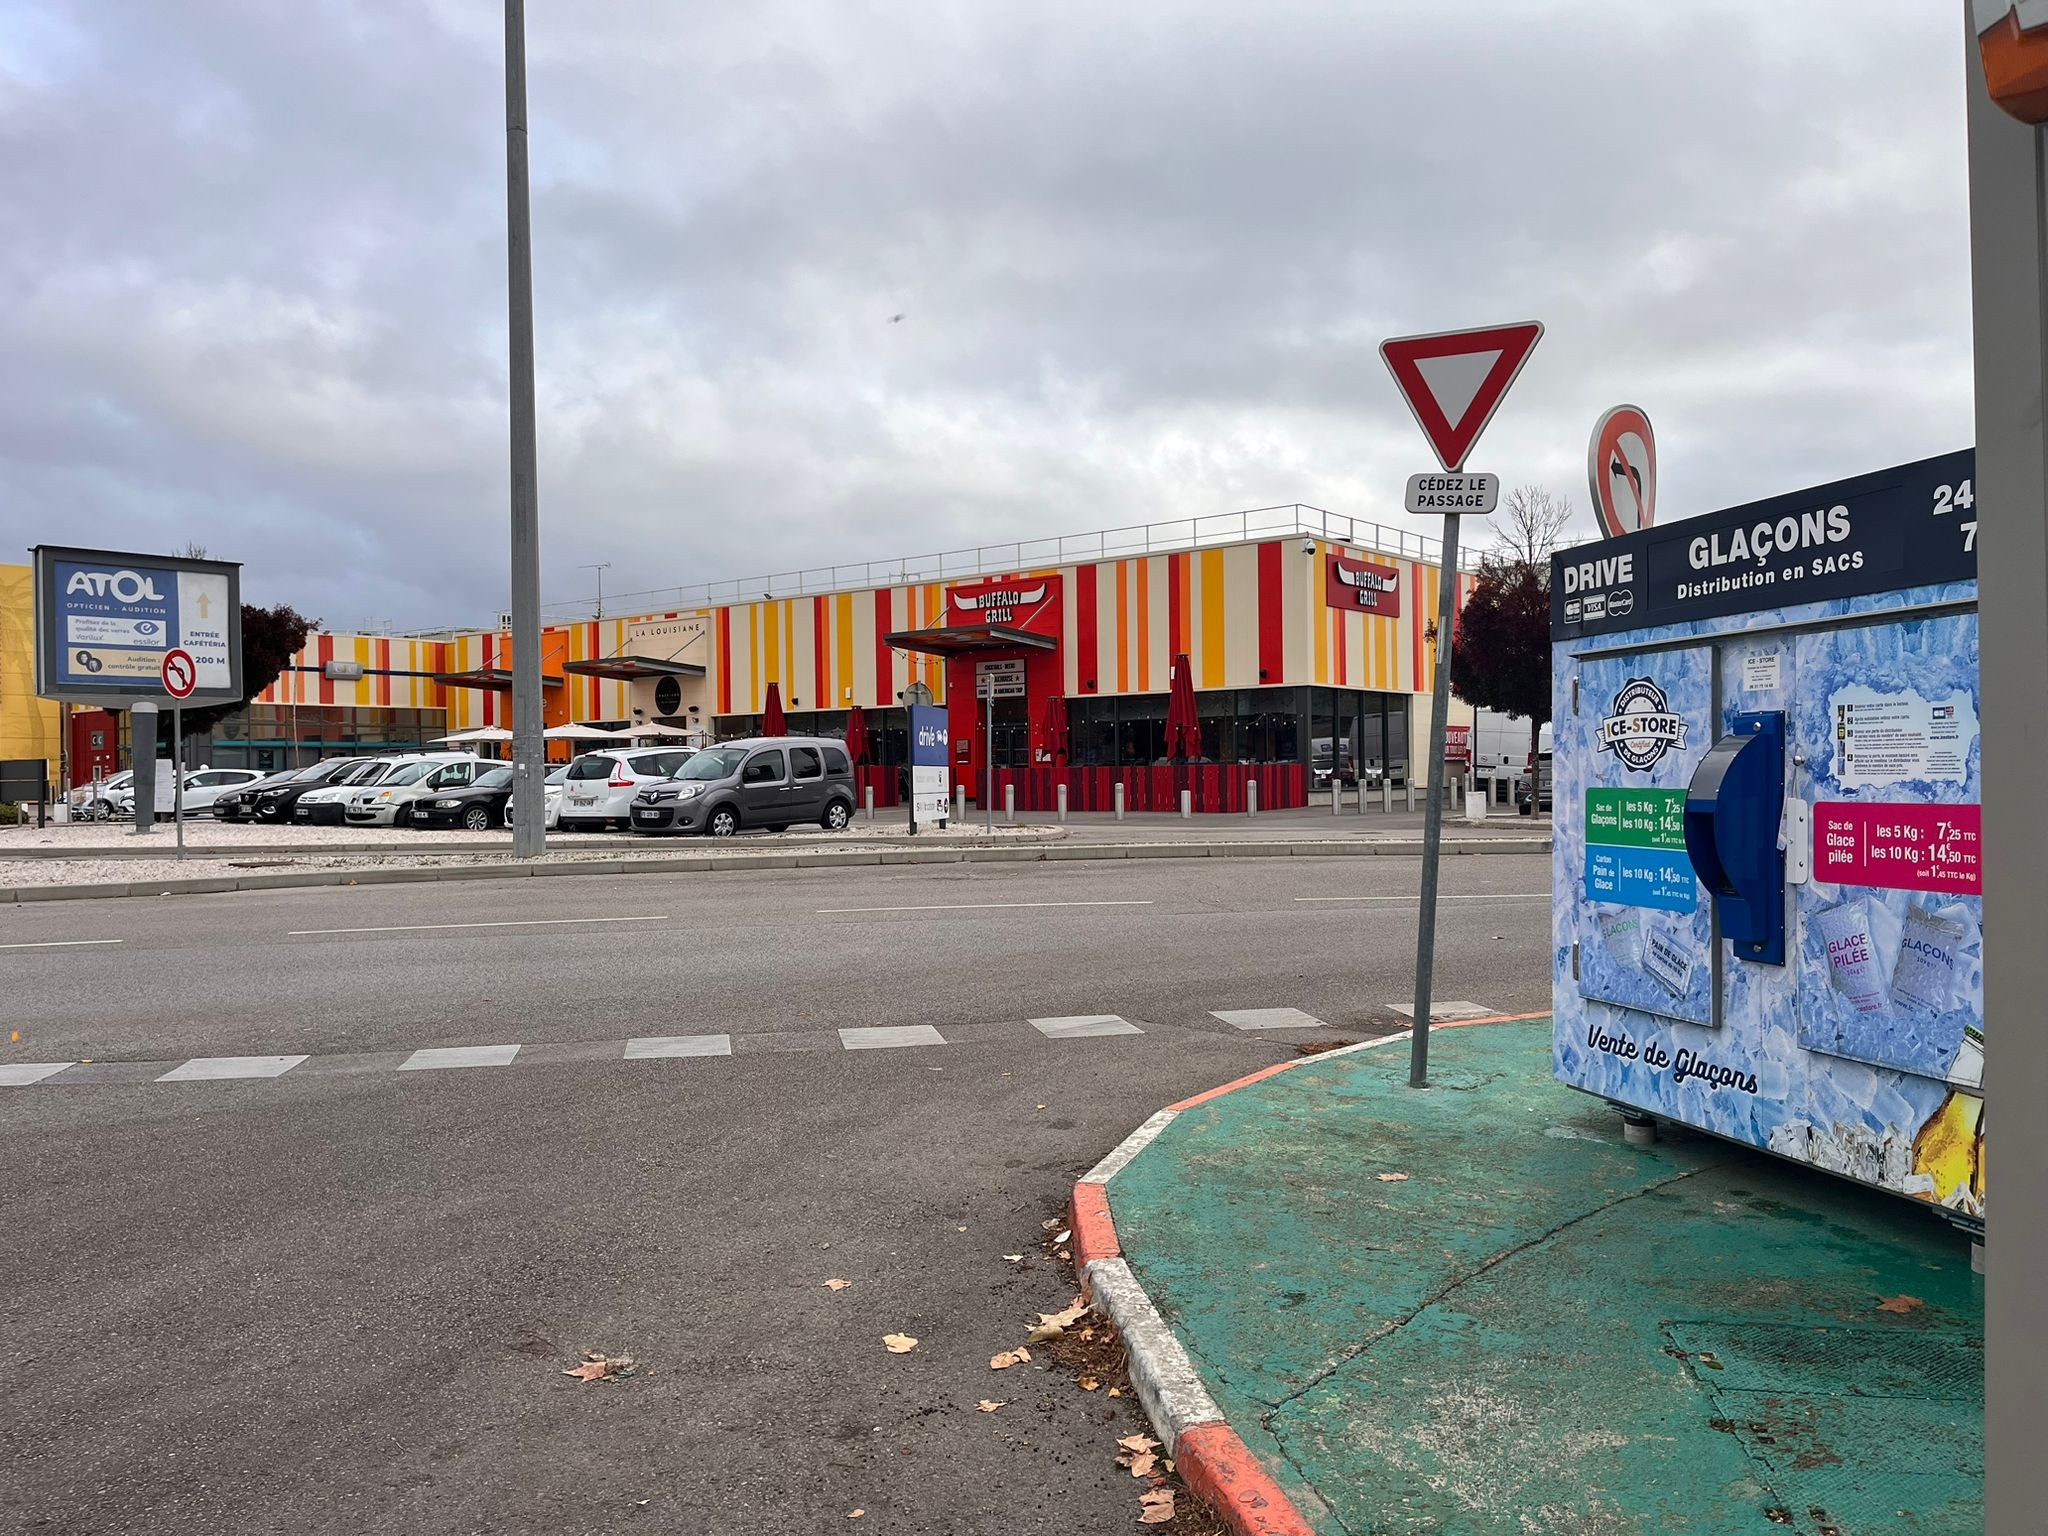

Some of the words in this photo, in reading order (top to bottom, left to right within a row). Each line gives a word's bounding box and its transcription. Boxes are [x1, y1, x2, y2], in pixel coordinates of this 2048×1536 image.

[1419, 477, 1463, 491] CÉDEZ
[1469, 479, 1487, 491] LE
[1417, 495, 1484, 507] PASSAGE
[1688, 504, 1851, 567] GLAÇONS
[1355, 571, 1382, 590] BUFFALO
[1564, 553, 1633, 594] DRIVE
[1677, 570, 1775, 600] Distribution
[1782, 563, 1804, 582] en
[1811, 551, 1864, 576] SACS
[66, 570, 165, 603] ATOL
[978, 590, 1019, 608] BUFFALO
[1360, 590, 1377, 606] GRILL
[66, 602, 110, 611] OPTICIEN
[121, 606, 167, 615] AUDITION
[1586, 602, 1602, 613] VISA
[985, 608, 1012, 623] GRILL
[190, 630, 220, 639] ENTRÉE
[651, 623, 700, 636] LOUISIANE
[133, 638, 160, 646] essilor
[183, 639, 226, 648] CAFÉTÉRIA
[195, 656, 214, 664] 200
[217, 657, 226, 665] M
[137, 664, 161, 672] gratuit
[1620, 686, 1660, 707] DISTRIBUTEUR
[1606, 717, 1677, 738] ICE-STORE
[918, 725, 936, 747] drive
[1623, 748, 1632, 759] DE
[1630, 747, 1659, 764] GLAÇONS
[1595, 803, 1605, 812] Sac
[1605, 804, 1612, 812] de
[1626, 801, 1636, 811] les
[1637, 801, 1642, 812] 5
[1643, 801, 1653, 814] Kg
[1591, 813, 1617, 827] Glaçons
[1622, 818, 1633, 828] les
[1634, 818, 1642, 829] 10
[1643, 819, 1653, 832] Kg
[1828, 820, 1842, 830] Sac
[1843, 820, 1853, 831] de
[1876, 824, 1891, 837] les
[1894, 826, 1901, 838] 5
[1903, 826, 1918, 842] Kg
[1963, 831, 1977, 841] TTC
[1826, 834, 1855, 847] Glace
[1828, 851, 1853, 864] pilée
[1871, 845, 1887, 859] les
[1889, 846, 1903, 859] 10
[1904, 846, 1919, 864] Kg
[1963, 855, 1977, 864] TTC
[1592, 865, 1607, 876] Pain
[1608, 869, 1615, 877] de
[1622, 866, 1633, 878] les
[1634, 868, 1643, 879] 10
[1643, 869, 1653, 882] Kg
[1947, 871, 1958, 879] TTC
[1594, 878, 1613, 890] Glace
[1828, 932, 1868, 954] GLACE
[1651, 938, 1664, 953] PAIN
[1664, 948, 1672, 959] DE
[1671, 953, 1688, 972] GLACE
[1834, 947, 1870, 968] PILÉE
[1901, 938, 1954, 971] GLAÇONS
[1587, 1024, 1639, 1060] Vente
[1643, 1041, 1670, 1068] de
[1673, 1048, 1758, 1094] Glaçons
